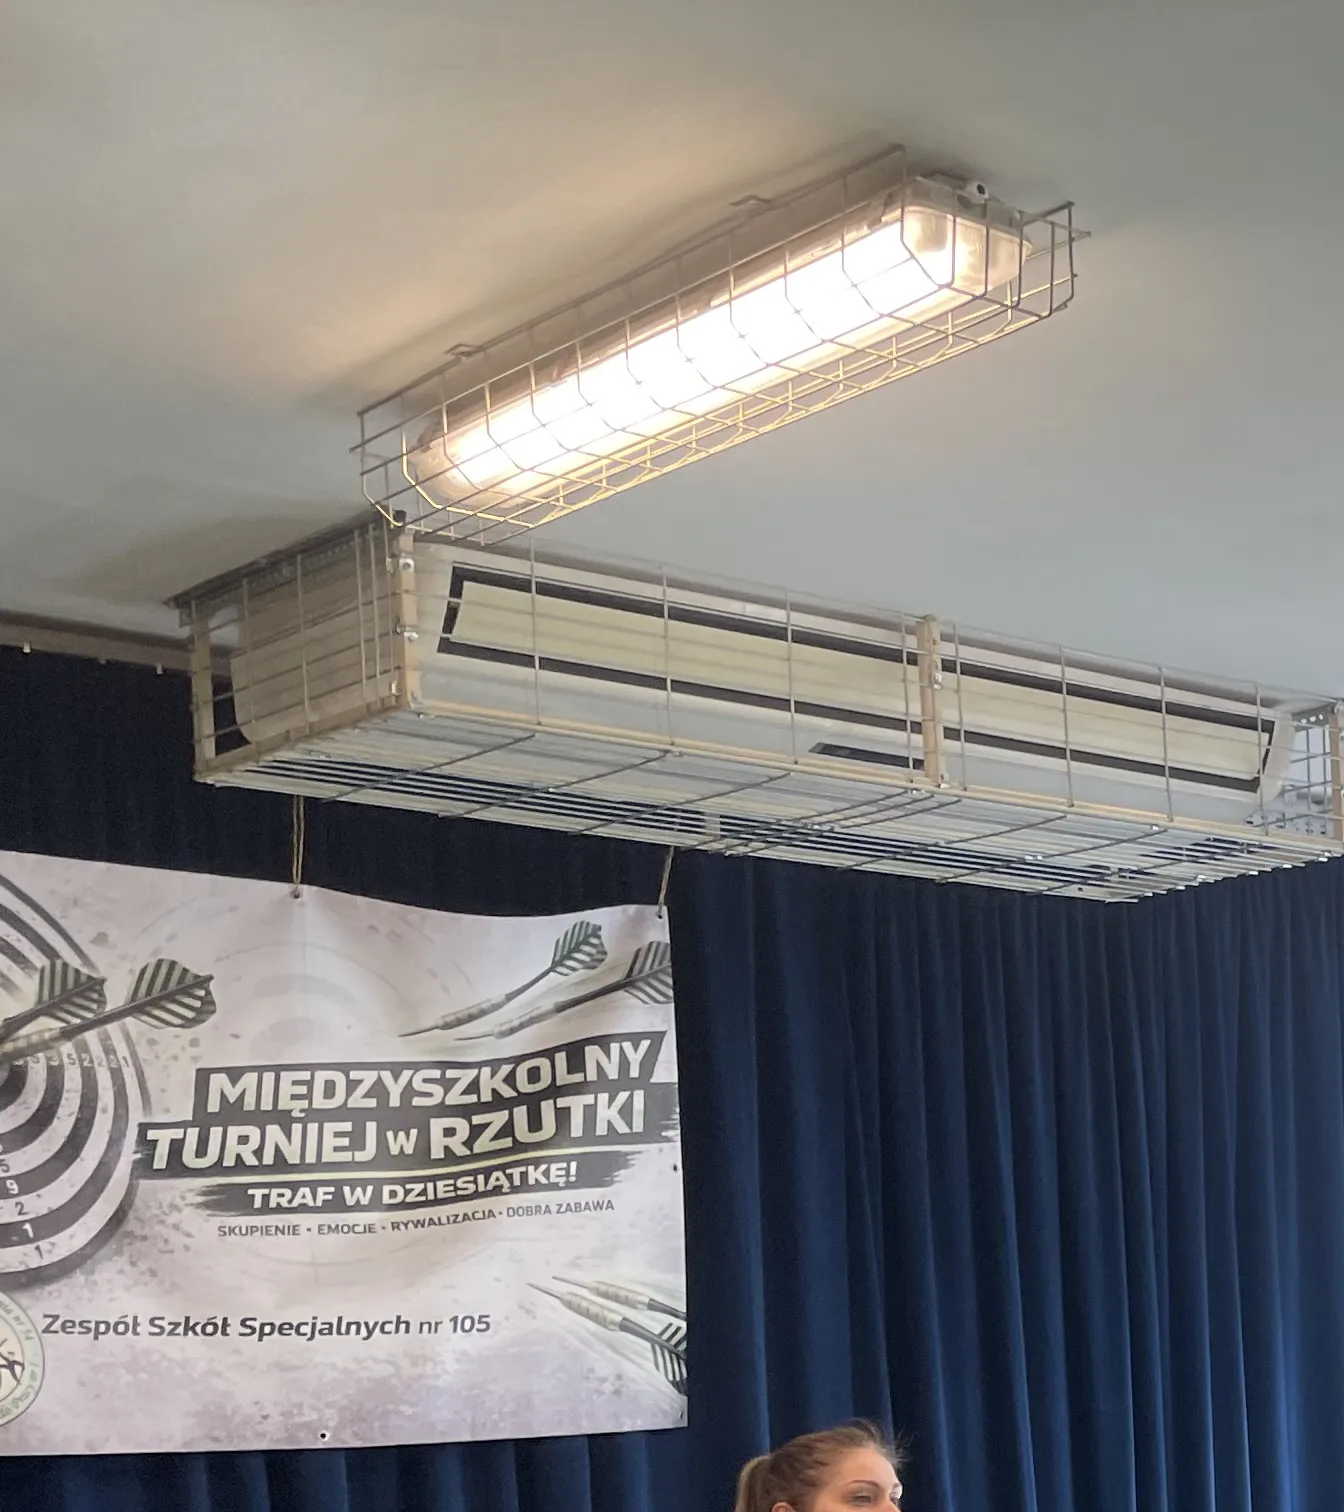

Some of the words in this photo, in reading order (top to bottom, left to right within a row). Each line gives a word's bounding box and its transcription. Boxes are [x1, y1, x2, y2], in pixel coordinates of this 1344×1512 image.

[207, 1039, 651, 1117] MIĘDZYSZKOLNY
[147, 1121, 377, 1170] TURNIEJ
[430, 1089, 645, 1160] RZUTKI
[247, 1186, 335, 1209] TRAF
[342, 1185, 374, 1206] W
[382, 1161, 577, 1205] DZIESIĄTKĘ!
[217, 1224, 300, 1237] SKUPIENIE
[317, 1223, 377, 1235] EMOCJE
[391, 1209, 496, 1232] RYWALIZACJA
[506, 1204, 551, 1217] DOBRA
[555, 1199, 615, 1214] ZABAWA
[41, 1314, 141, 1341] Zespół
[148, 1316, 231, 1337] Szkół
[238, 1315, 411, 1342] Specjalnych
[418, 1319, 443, 1334] nr
[449, 1315, 491, 1334] 105
